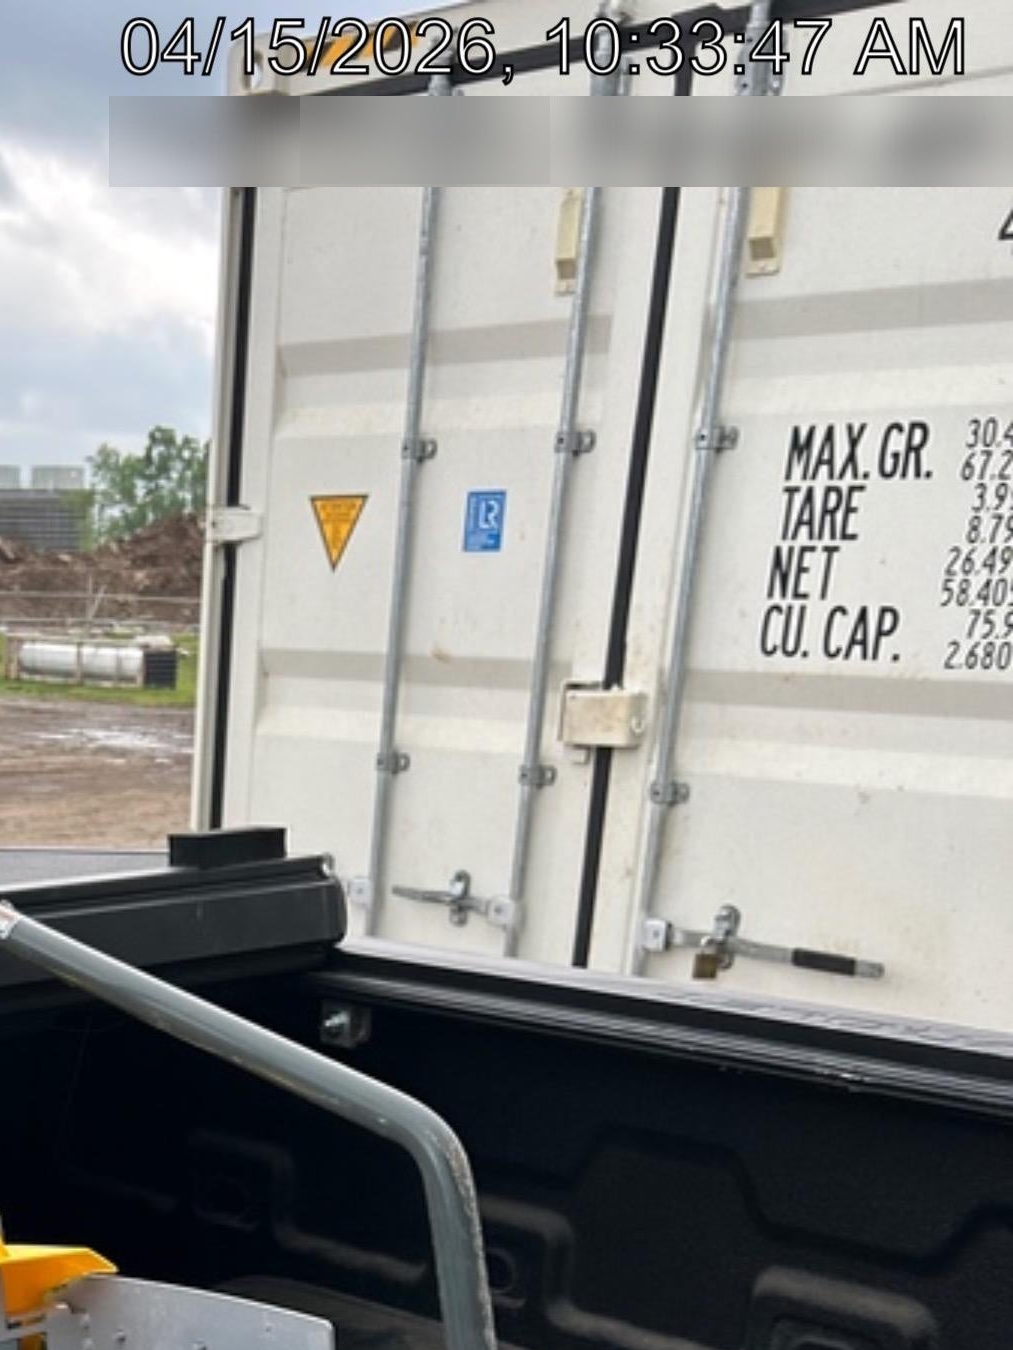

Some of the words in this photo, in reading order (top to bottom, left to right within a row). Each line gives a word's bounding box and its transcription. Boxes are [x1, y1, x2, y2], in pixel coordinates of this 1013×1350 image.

[781, 485, 866, 541] TARE
[971, 482, 1013, 511] 3.9
[766, 545, 841, 601] NET
[760, 603, 809, 658] CU.
[823, 604, 901, 662] CAP.
